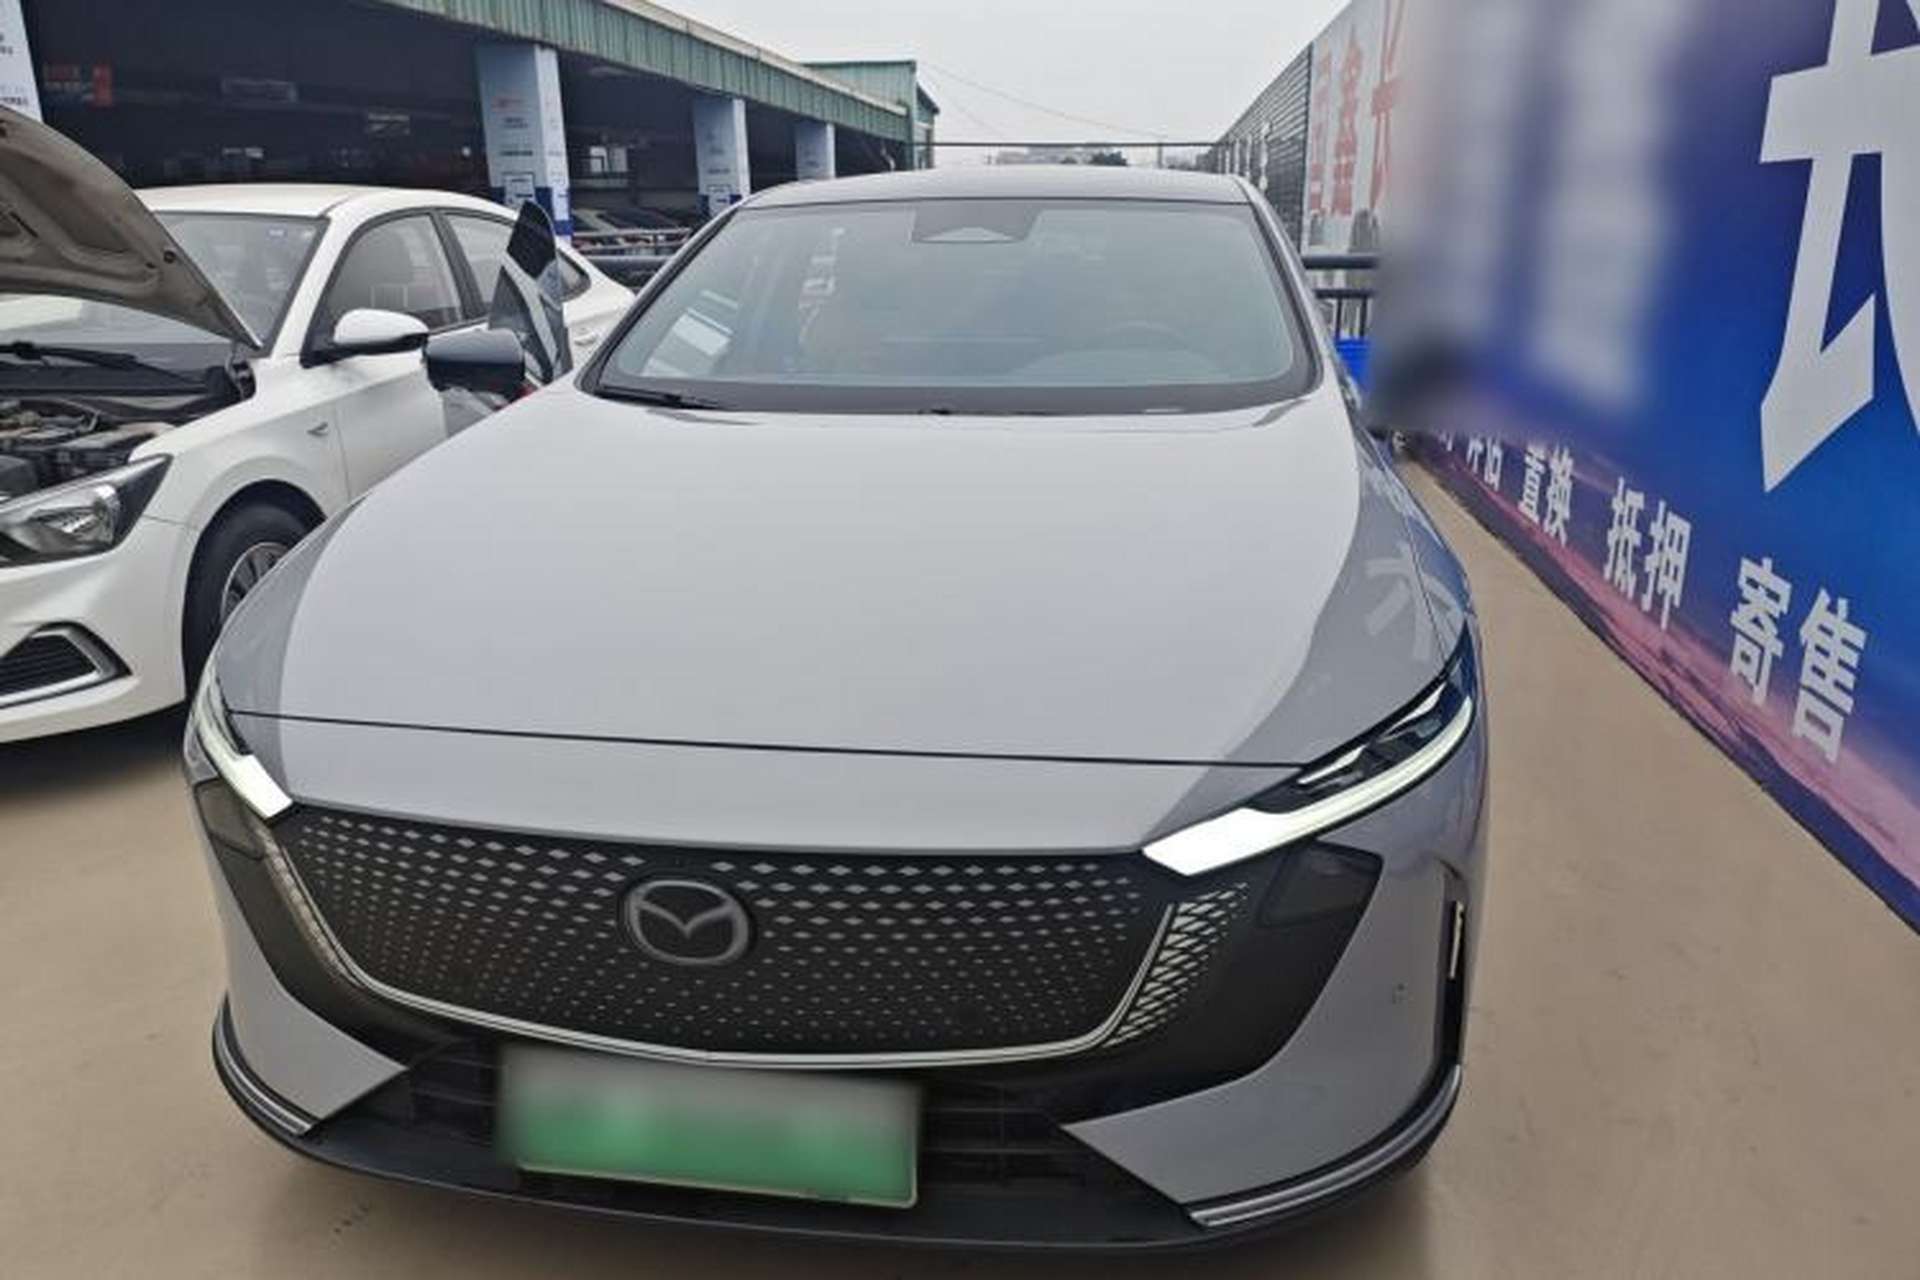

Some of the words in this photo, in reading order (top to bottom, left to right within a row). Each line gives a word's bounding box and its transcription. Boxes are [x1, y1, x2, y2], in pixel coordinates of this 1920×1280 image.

[1518, 441, 1574, 548] 置换
[1603, 476, 1692, 630] 抵押
[1730, 556, 1867, 763] 寄售
